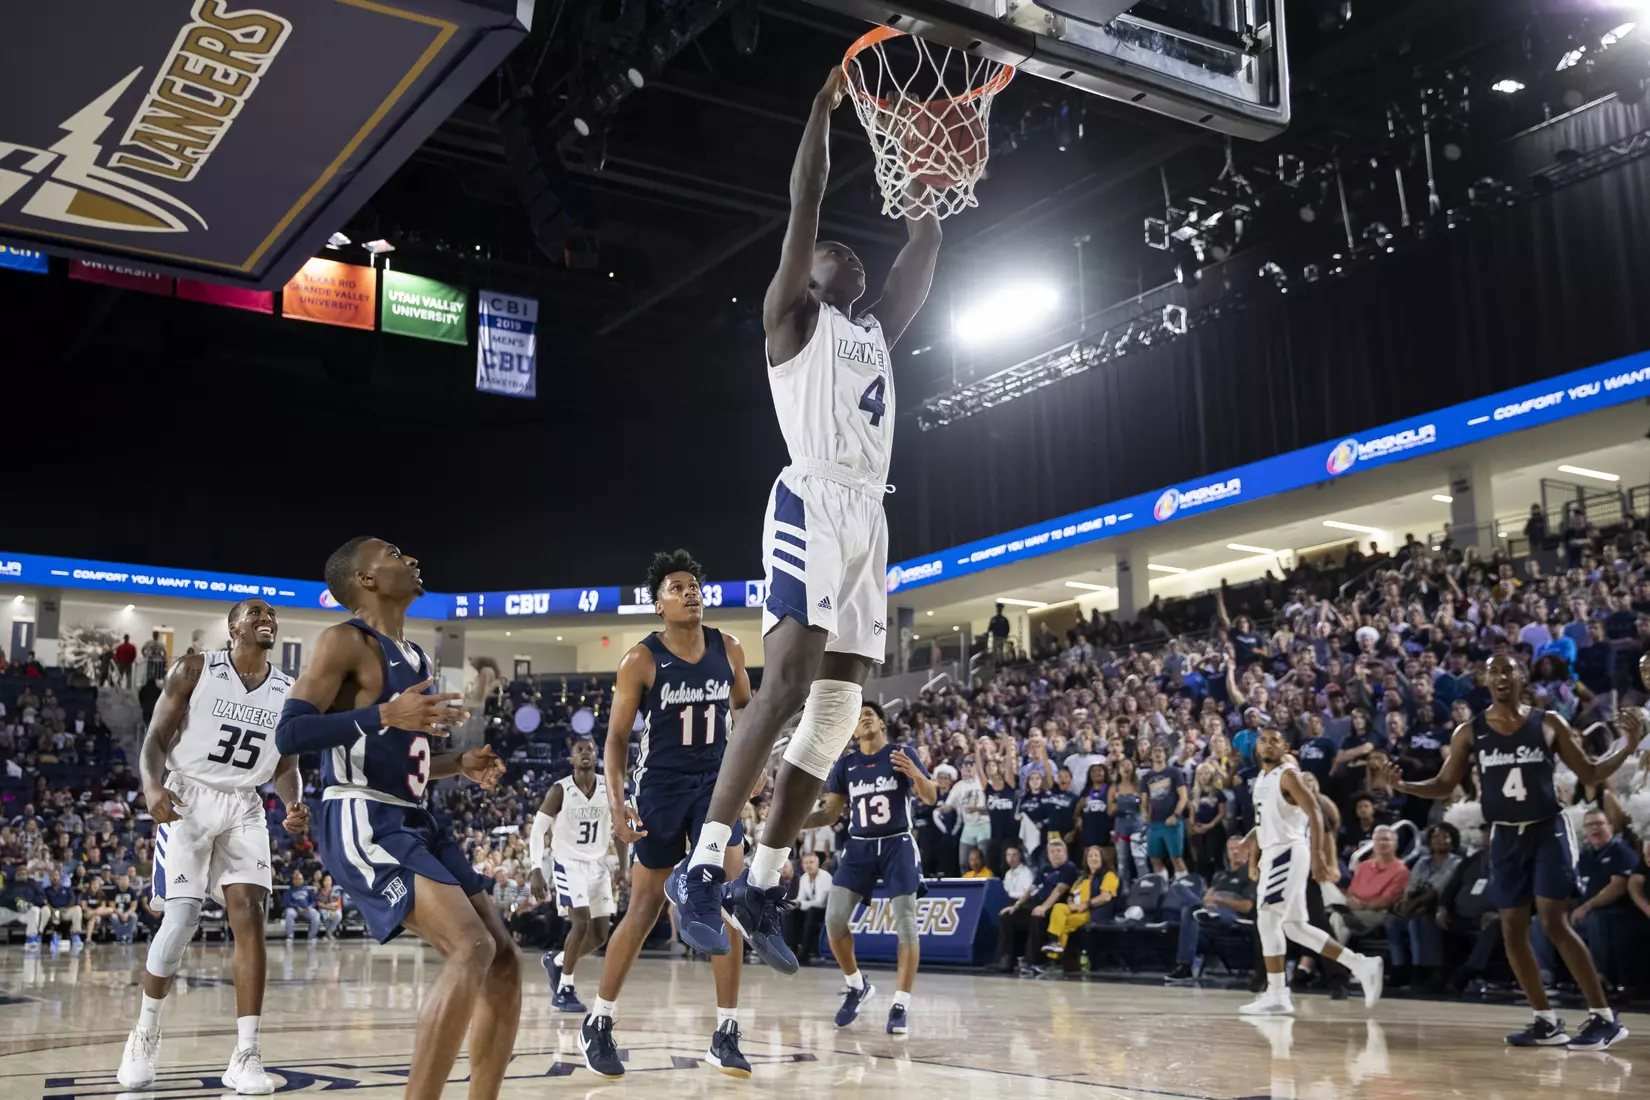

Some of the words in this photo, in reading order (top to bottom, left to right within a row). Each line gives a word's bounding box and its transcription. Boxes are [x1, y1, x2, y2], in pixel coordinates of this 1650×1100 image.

[107, 0, 293, 182] LANCERS
[289, 282, 331, 297] GRANDE
[335, 290, 370, 302] VALLEY
[304, 273, 336, 286] TEXAS
[338, 277, 356, 289] RIO
[299, 295, 359, 312] UNIVERSITY
[388, 289, 420, 306] UTAH
[421, 296, 464, 313] VALLEY
[391, 303, 460, 325] UNIVERSITY
[491, 298, 528, 317] CBI
[483, 349, 533, 374] CBU
[858, 375, 886, 427] 4
[1493, 390, 1565, 421] COMFORT
[1567, 381, 1601, 400] YOU
[1603, 366, 1650, 391] WANT
[970, 544, 1007, 563] COMFORT
[1007, 540, 1024, 553] YOU
[1024, 532, 1050, 548] WANT
[1051, 528, 1063, 541] TO
[1063, 525, 1076, 538] GO
[1076, 517, 1103, 534] HOME
[1103, 514, 1117, 527] TO
[73, 569, 129, 582] COMFORT
[131, 574, 154, 585] YOU
[156, 576, 191, 588] WANT
[193, 580, 208, 590] TO
[210, 582, 227, 592] GO
[228, 584, 260, 595] HOME
[262, 586, 277, 596] TO
[702, 584, 722, 607] 33
[505, 593, 550, 615] CBU
[578, 590, 599, 612] 49
[660, 680, 704, 711] Jackson
[212, 698, 278, 730] LANCERS
[679, 702, 716, 746] 11
[207, 723, 267, 770] 35
[1516, 745, 1544, 764] State
[407, 736, 431, 798] 3
[876, 775, 898, 793] State
[1501, 767, 1527, 801] 4
[857, 794, 891, 828] 13
[576, 820, 599, 844] 31
[848, 896, 966, 936] LANERS
